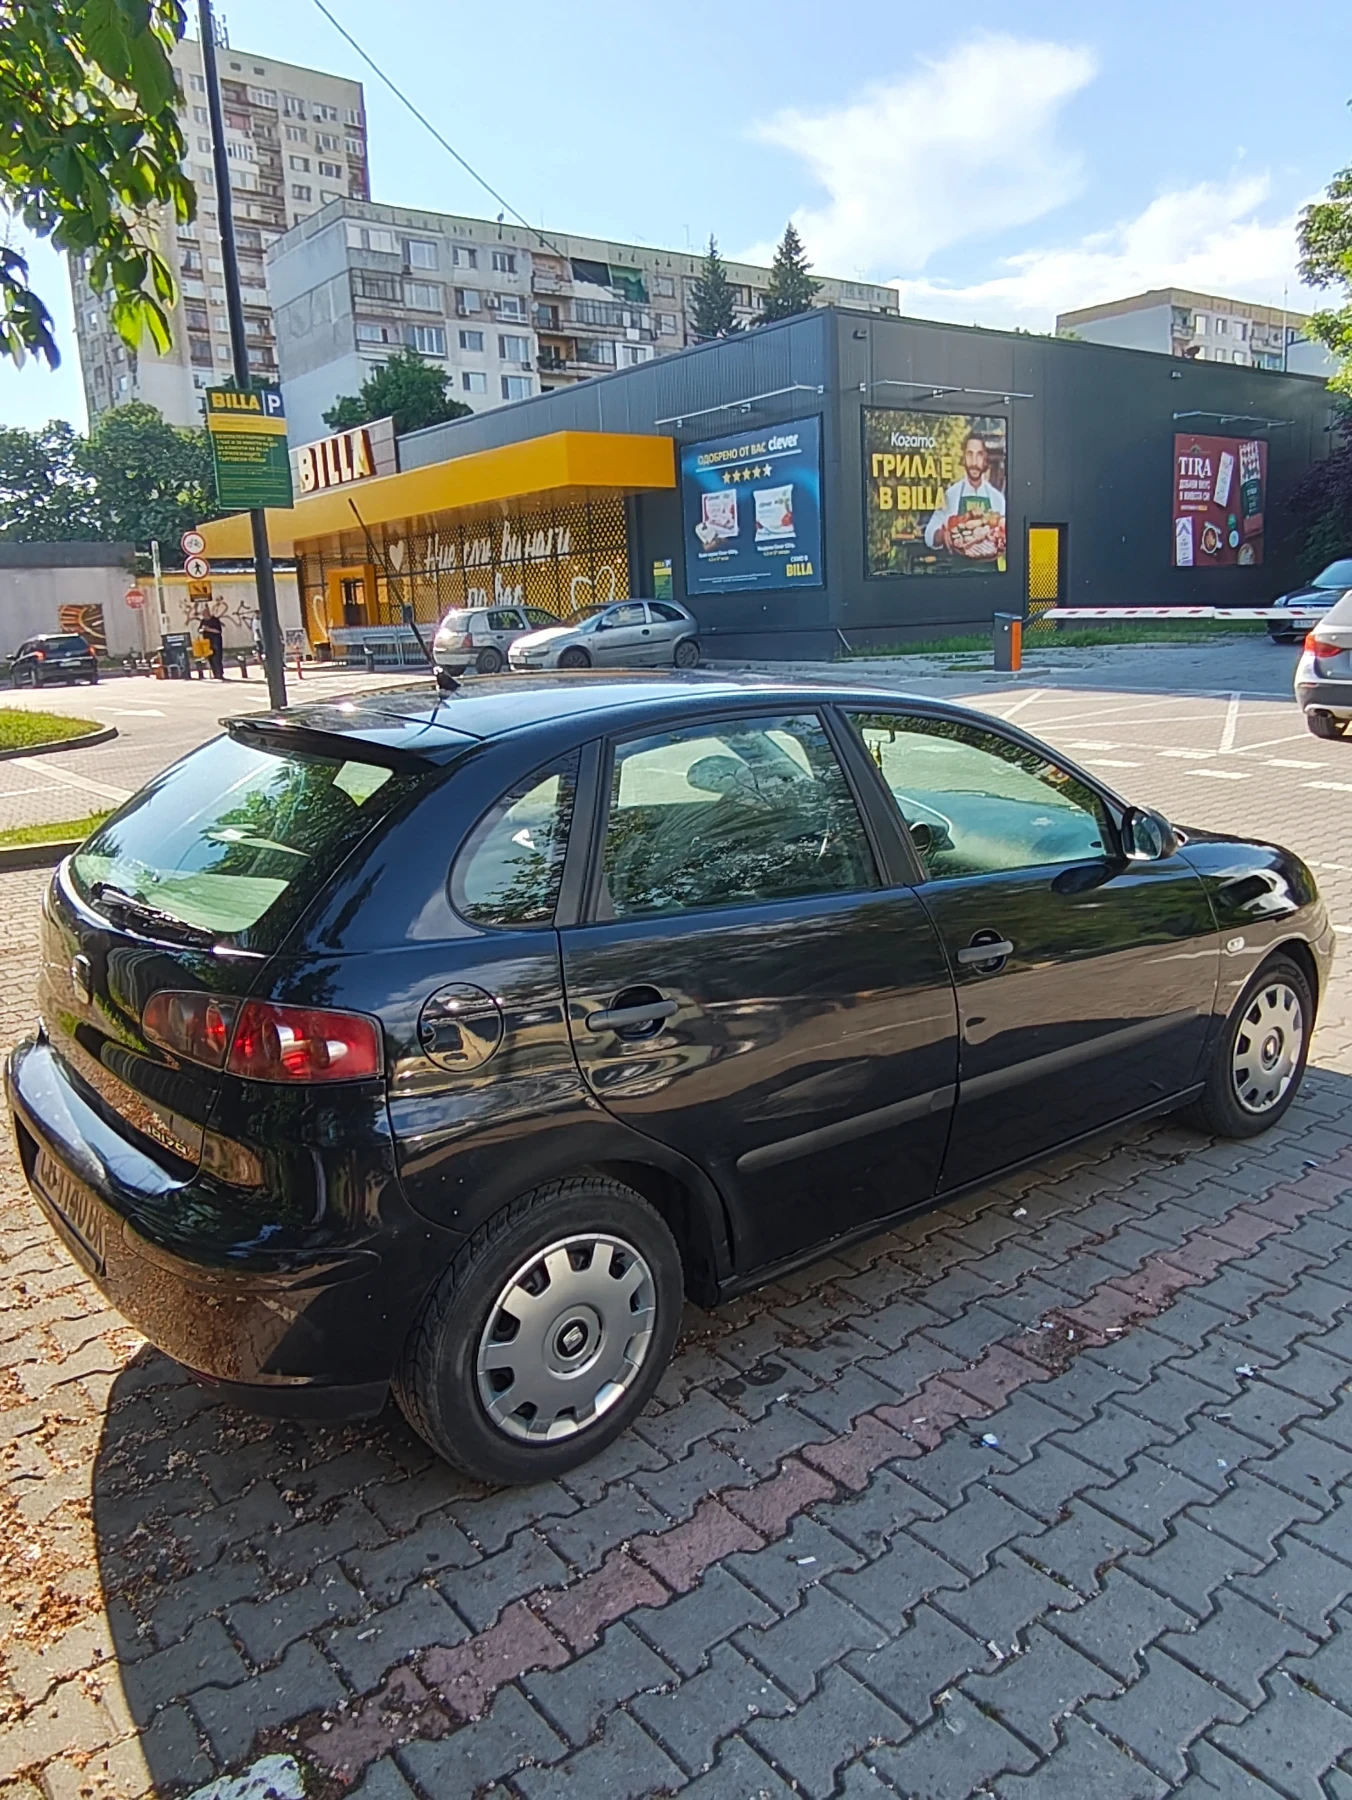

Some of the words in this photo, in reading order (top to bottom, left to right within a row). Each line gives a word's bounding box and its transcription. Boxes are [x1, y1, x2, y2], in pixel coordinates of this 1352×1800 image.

[211, 393, 260, 410] BILLA
[267, 394, 280, 413] P
[768, 434, 798, 451] clever
[298, 428, 374, 494] BILLA
[697, 448, 737, 466] ОДОБРЕНО
[739, 445, 750, 457] ОТ
[751, 441, 766, 455] ВАС
[1178, 456, 1212, 478] TIRA
[897, 486, 946, 511] BILLA
[786, 562, 813, 577] BILLA
